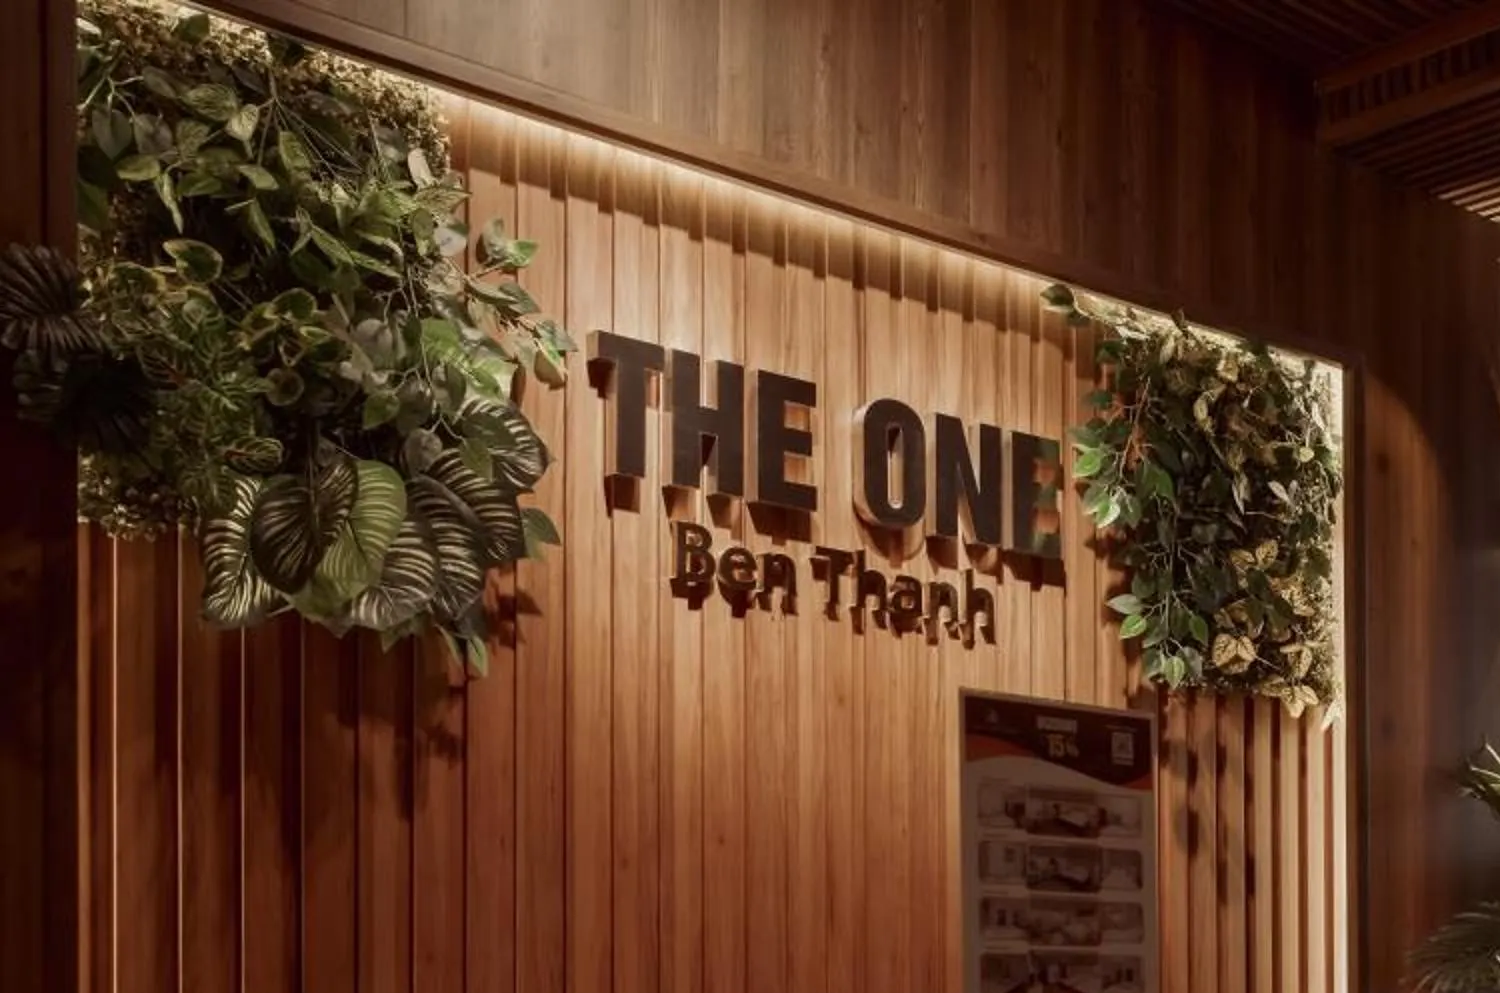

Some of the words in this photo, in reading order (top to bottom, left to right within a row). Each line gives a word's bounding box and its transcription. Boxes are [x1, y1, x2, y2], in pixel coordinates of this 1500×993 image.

[587, 330, 818, 514] THE
[853, 397, 1063, 560] ONE
[671, 521, 797, 603] Ben
[814, 545, 996, 641] Thanh
